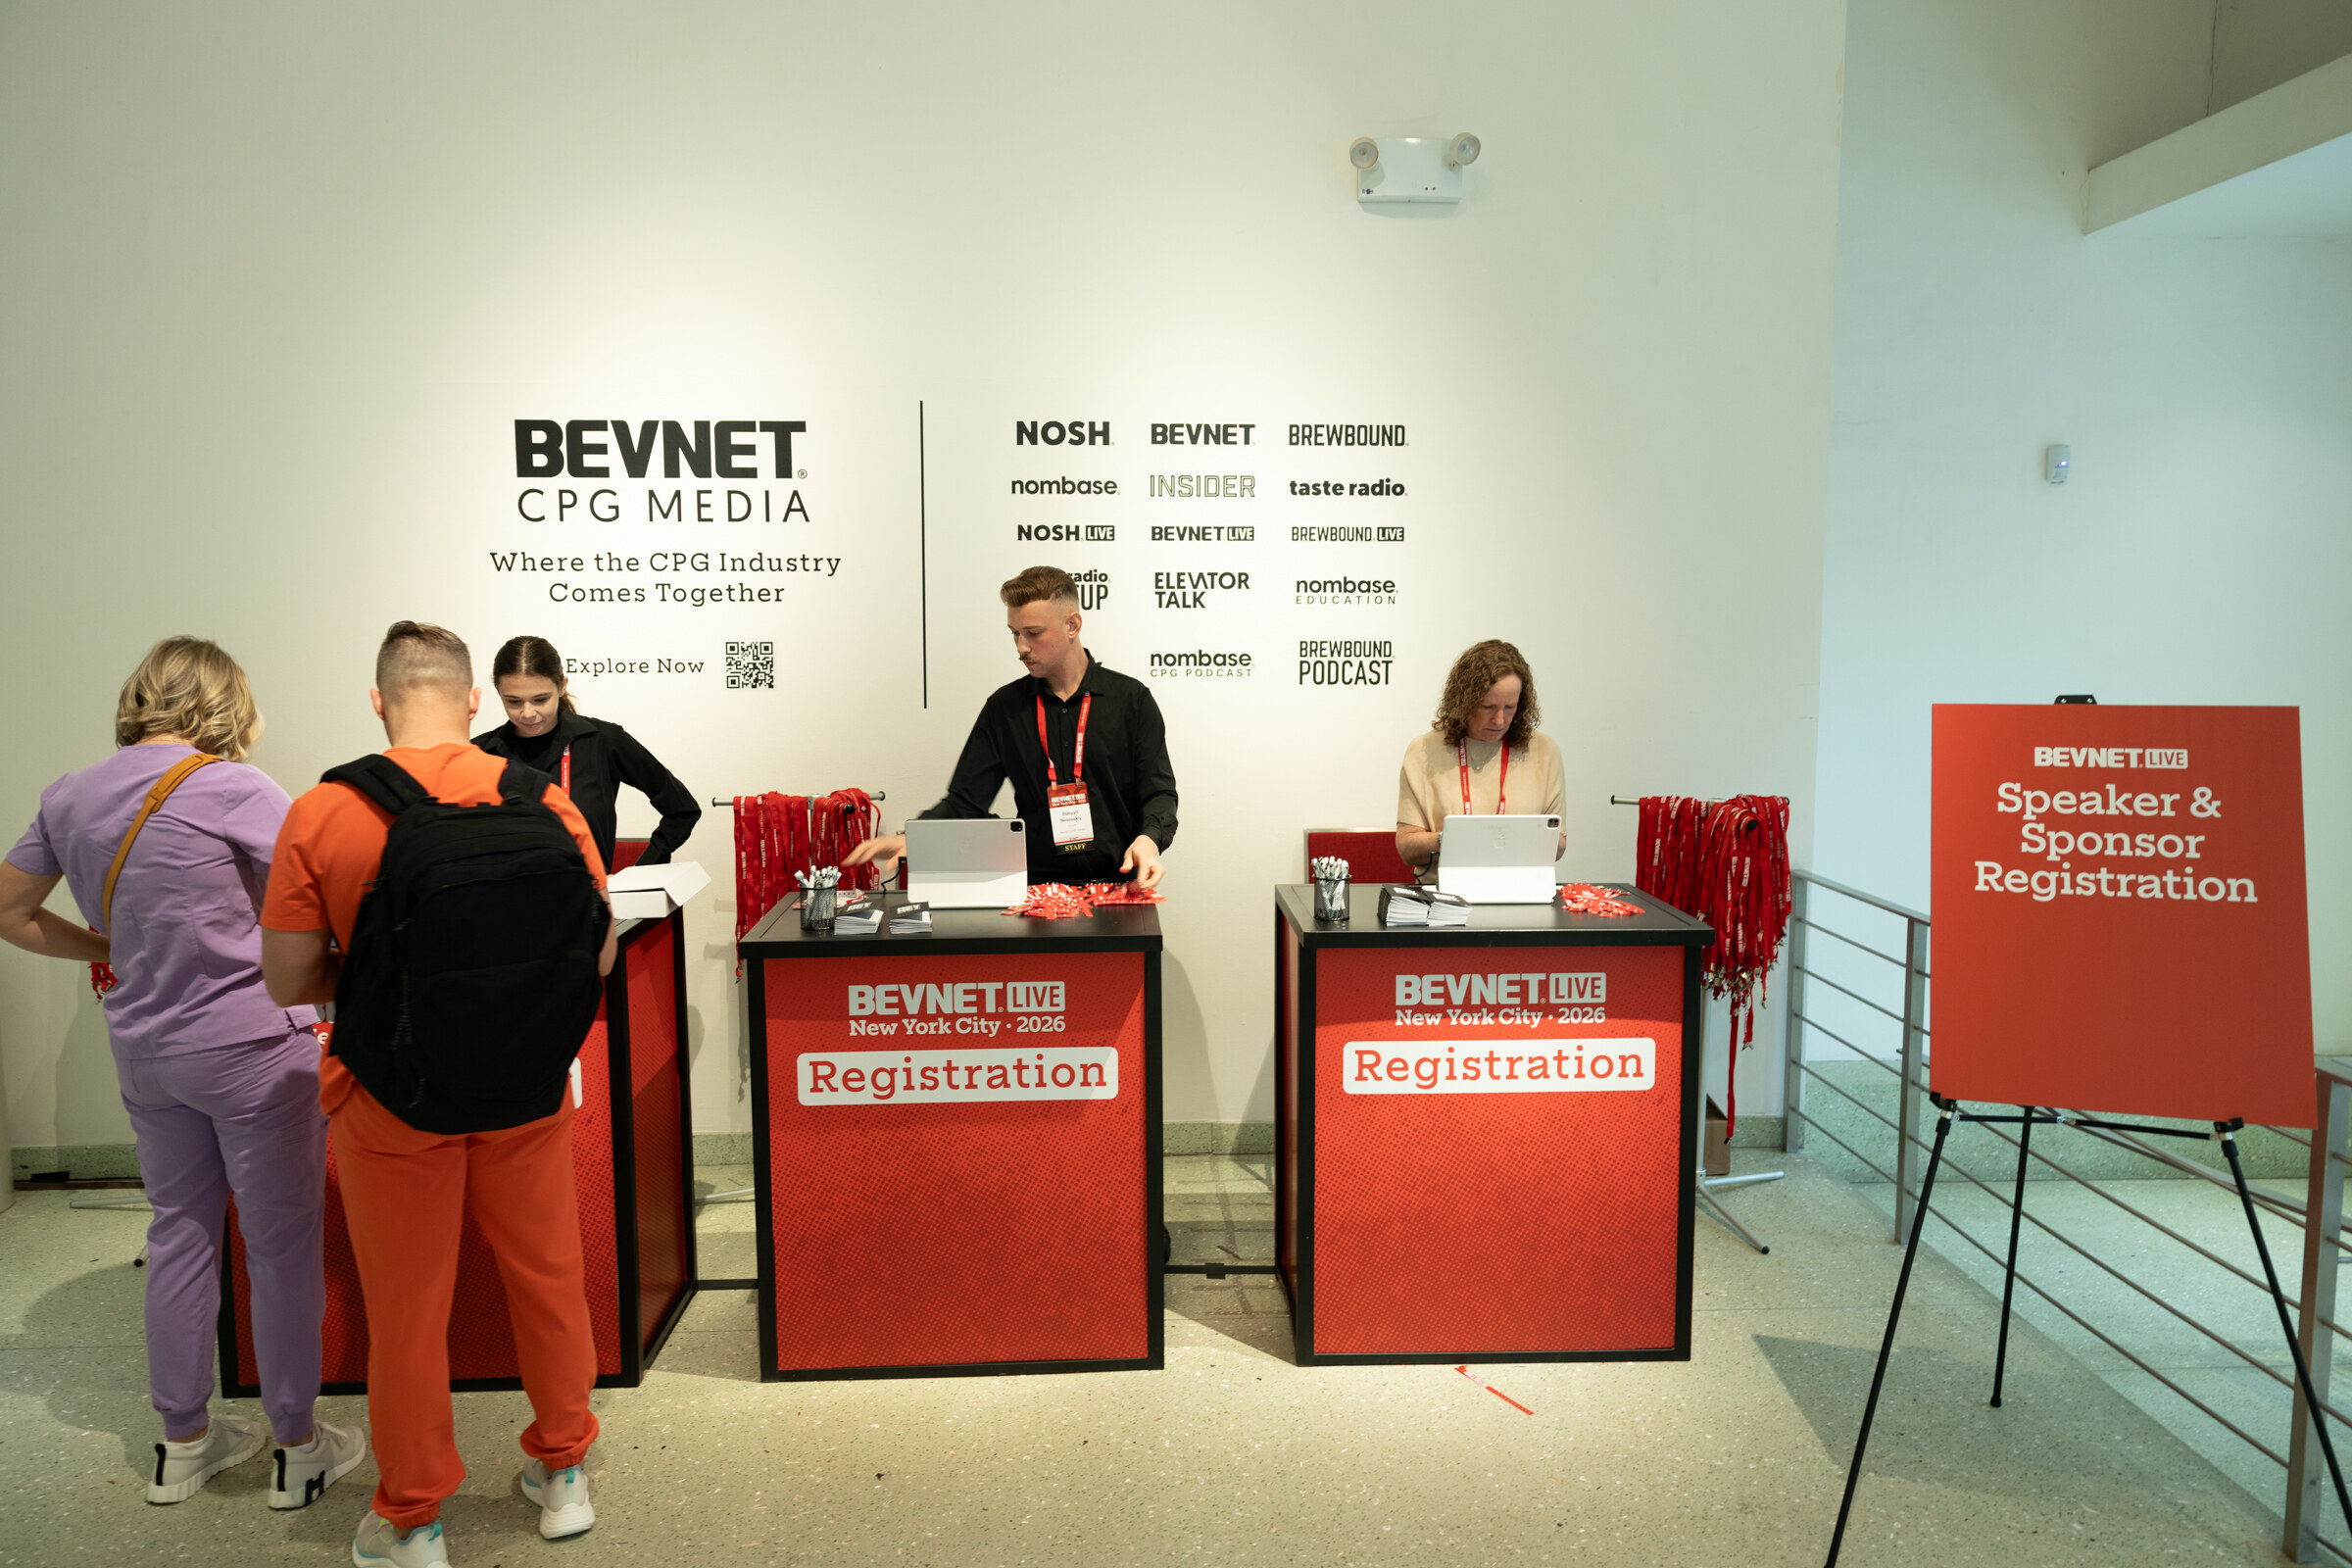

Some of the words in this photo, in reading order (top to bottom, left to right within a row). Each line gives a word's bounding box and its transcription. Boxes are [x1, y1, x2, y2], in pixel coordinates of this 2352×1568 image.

[1016, 421, 1109, 446] NOSH
[1152, 423, 1255, 445] BEVNET
[1290, 424, 1406, 446] BREWBOUND
[1011, 476, 1117, 494] nombase
[1151, 475, 1255, 497] INSIDER
[1290, 481, 1345, 496] taste
[1349, 478, 1404, 496] radio
[518, 489, 619, 522] CPG
[649, 490, 809, 522] MEDIA
[1018, 525, 1079, 541] NOSH
[1087, 526, 1114, 541] LIVE
[1152, 526, 1224, 541] BEVNET
[1228, 527, 1253, 541] LIVE
[1292, 527, 1372, 541] BREWBOUND
[1378, 528, 1403, 541] LIVE
[490, 552, 583, 571] Where
[594, 552, 639, 571] the
[650, 553, 709, 571] CPG
[719, 553, 841, 576] Industry
[1155, 572, 1250, 590] ELEVATOR
[1297, 576, 1396, 593] nombase
[550, 583, 645, 602] Comes
[656, 583, 784, 607] Together
[1076, 584, 1108, 611] UP
[1155, 591, 1205, 609] TALK
[1297, 595, 1396, 604] EDUCATION
[1151, 650, 1251, 666] nombase
[1299, 641, 1392, 658] BREWBOUND
[566, 659, 649, 677] Explore
[658, 659, 704, 673] Now
[1299, 661, 1393, 685] PODCAST
[2034, 747, 2142, 767] BEVNET
[2149, 752, 2184, 766] LIVE
[1998, 782, 2180, 820] Speaker
[2190, 787, 2221, 817] &
[1064, 843, 1086, 852] STAFF
[2021, 822, 2205, 860] Sponsor
[1975, 861, 2258, 902] Registration
[1011, 984, 1060, 1009] LIVE
[1554, 975, 1601, 1000] LIVE
[850, 1020, 898, 1036] New
[902, 1018, 952, 1034] York
[956, 1016, 1001, 1037] City
[1017, 1016, 1065, 1032] 2026
[1396, 1010, 1442, 1026] New
[1447, 1008, 1494, 1025] York
[1498, 1007, 1543, 1028] City
[1558, 1007, 1605, 1024] 2026
[809, 1054, 1106, 1100] Registration
[1354, 1048, 1644, 1090] Registration
